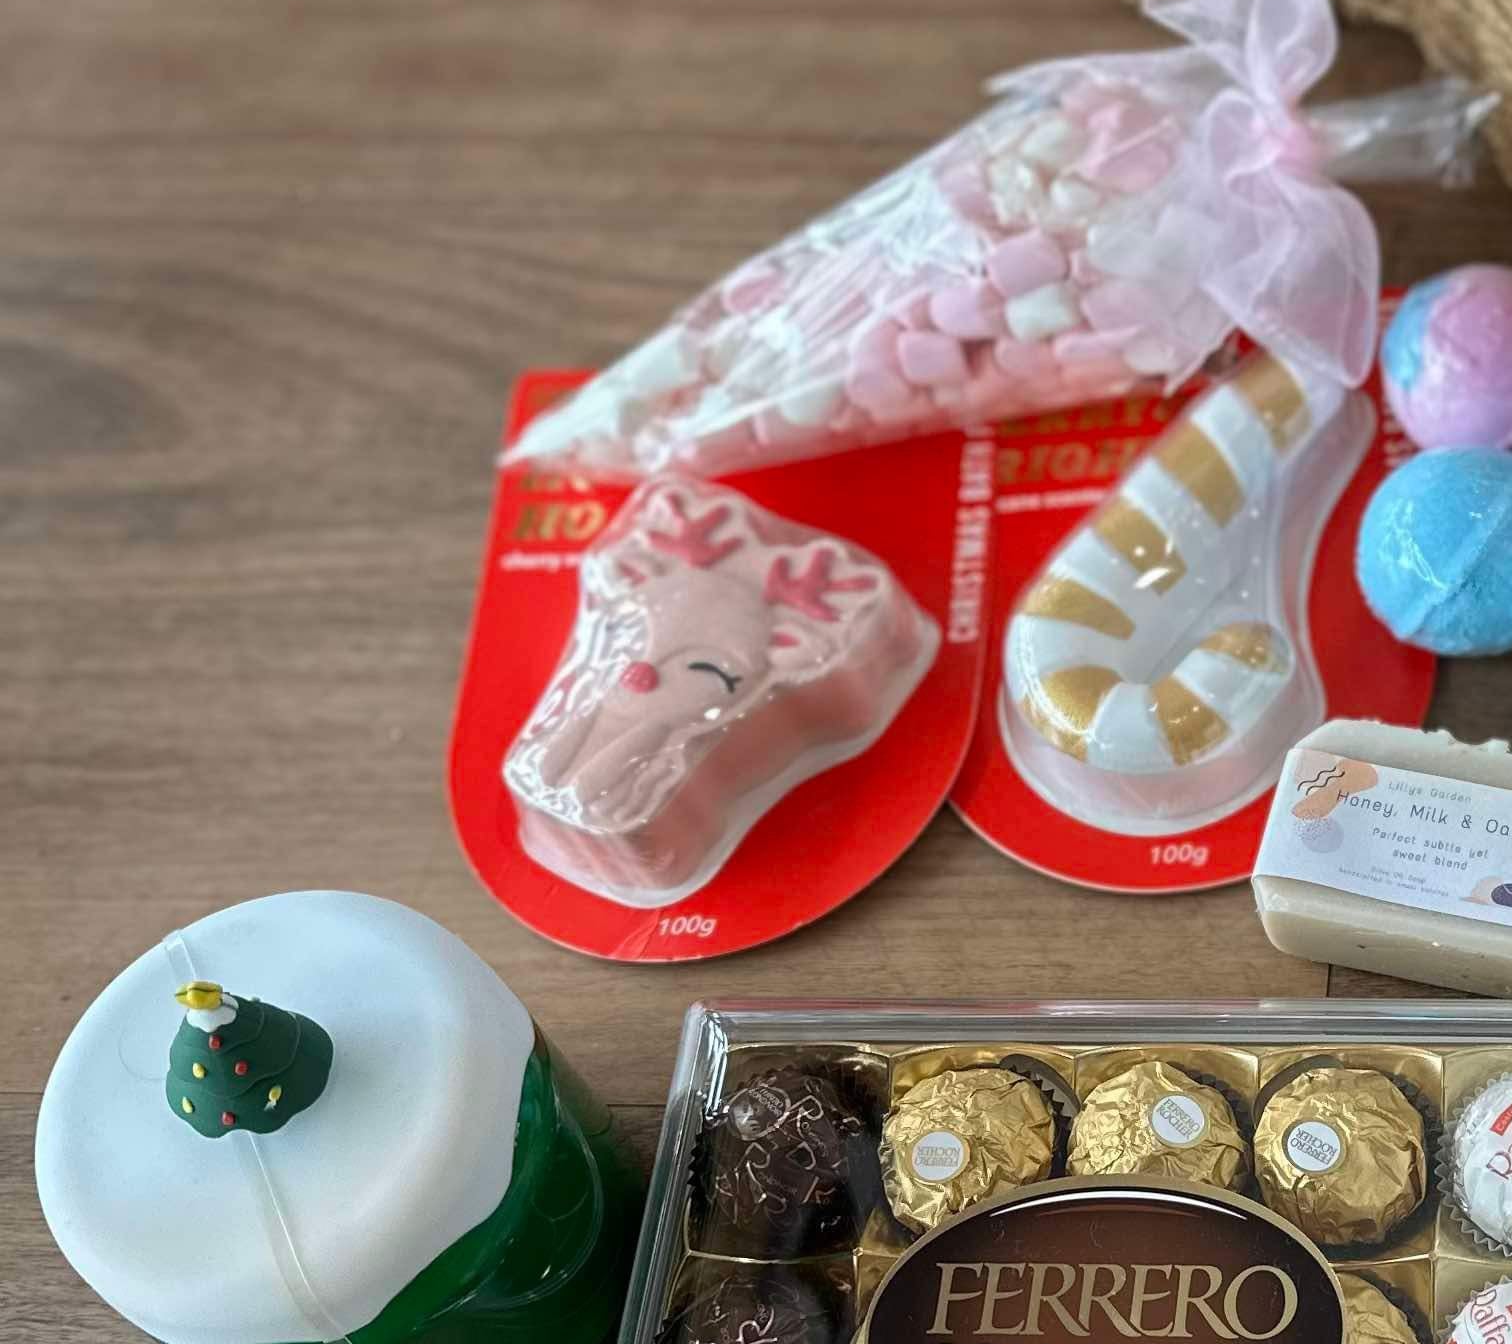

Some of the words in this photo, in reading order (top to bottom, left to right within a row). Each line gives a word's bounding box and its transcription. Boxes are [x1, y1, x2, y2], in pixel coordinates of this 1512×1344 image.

[1429, 787, 1473, 804] Garden
[1335, 789, 1399, 819] Honey,
[1409, 804, 1449, 826] Milk
[1461, 814, 1473, 829] &
[1149, 843, 1210, 868] 100g
[1392, 849, 1428, 865] sweet
[1434, 855, 1468, 871] blend
[657, 916, 717, 939] 100g
[925, 1261, 1298, 1341] FERRERO
